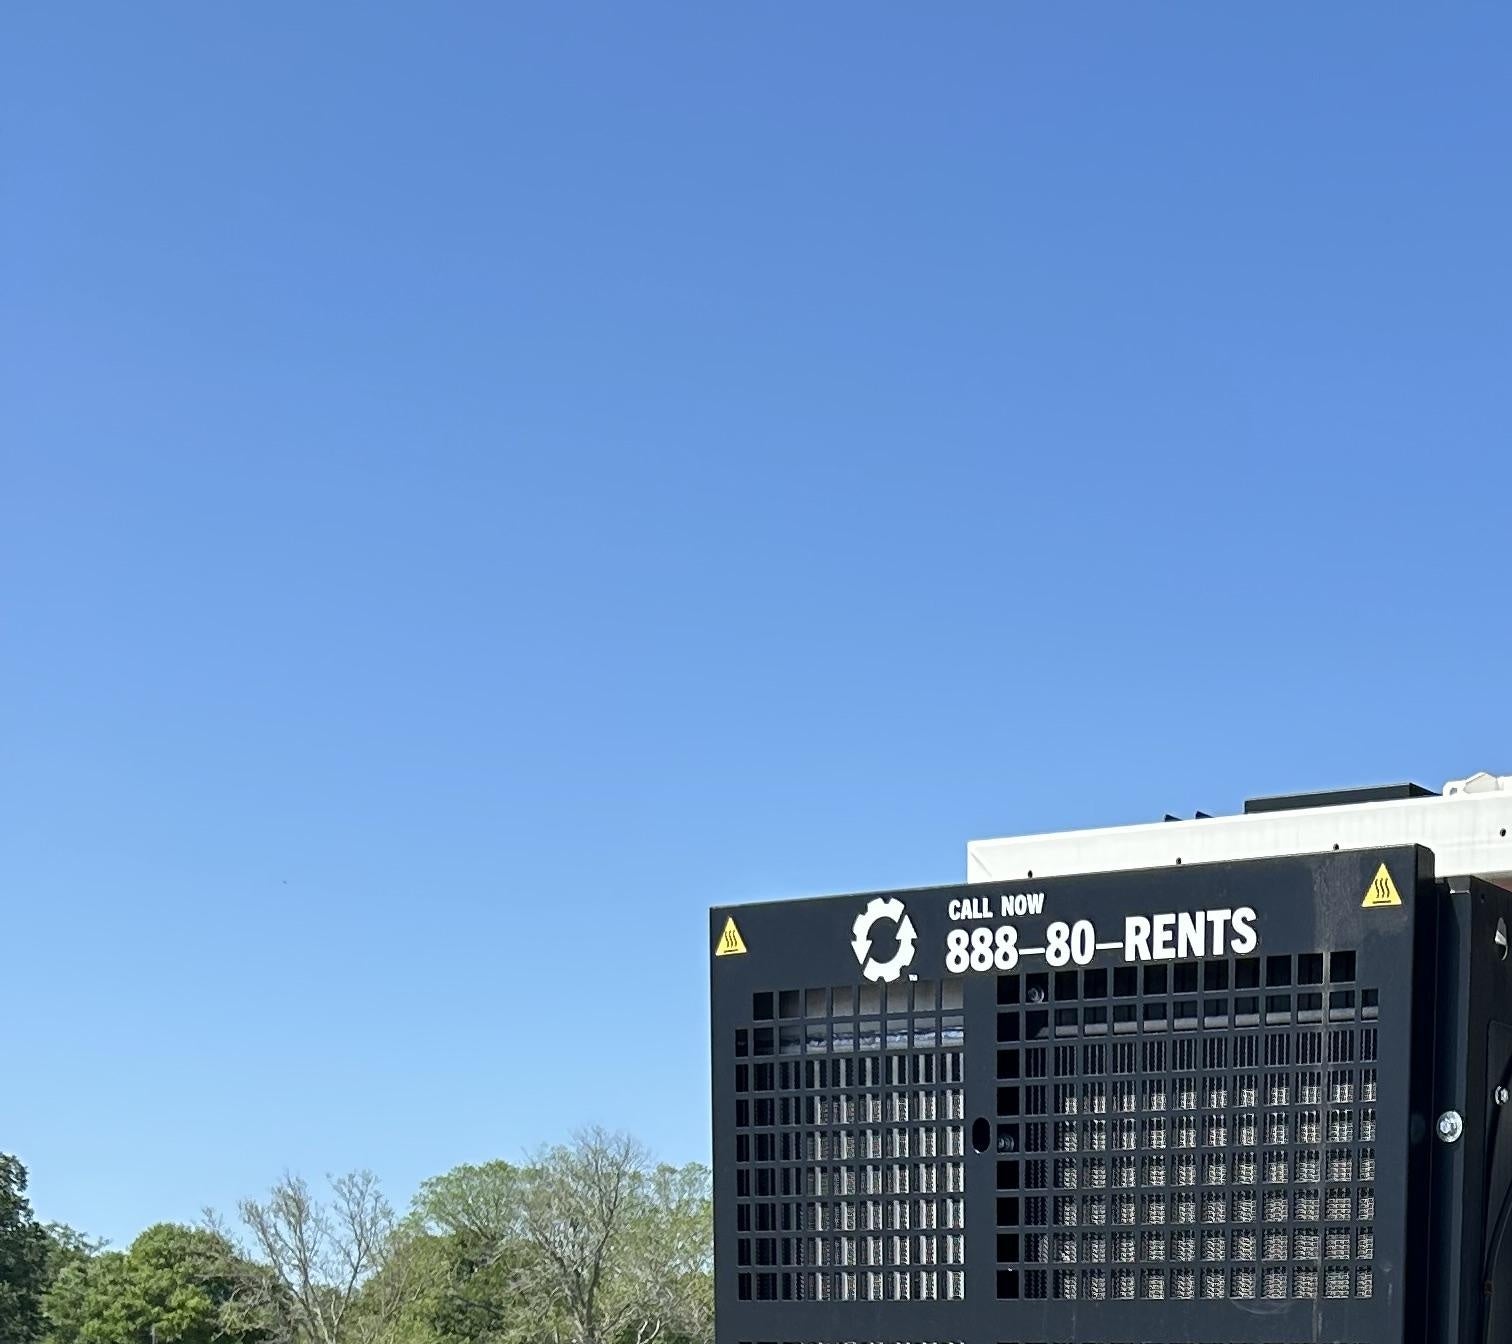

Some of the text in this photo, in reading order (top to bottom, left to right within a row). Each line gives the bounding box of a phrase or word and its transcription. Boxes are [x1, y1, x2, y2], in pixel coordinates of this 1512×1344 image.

[948, 893, 1045, 921] CALL NOW
[945, 907, 1258, 974] 888-80-RENTS
